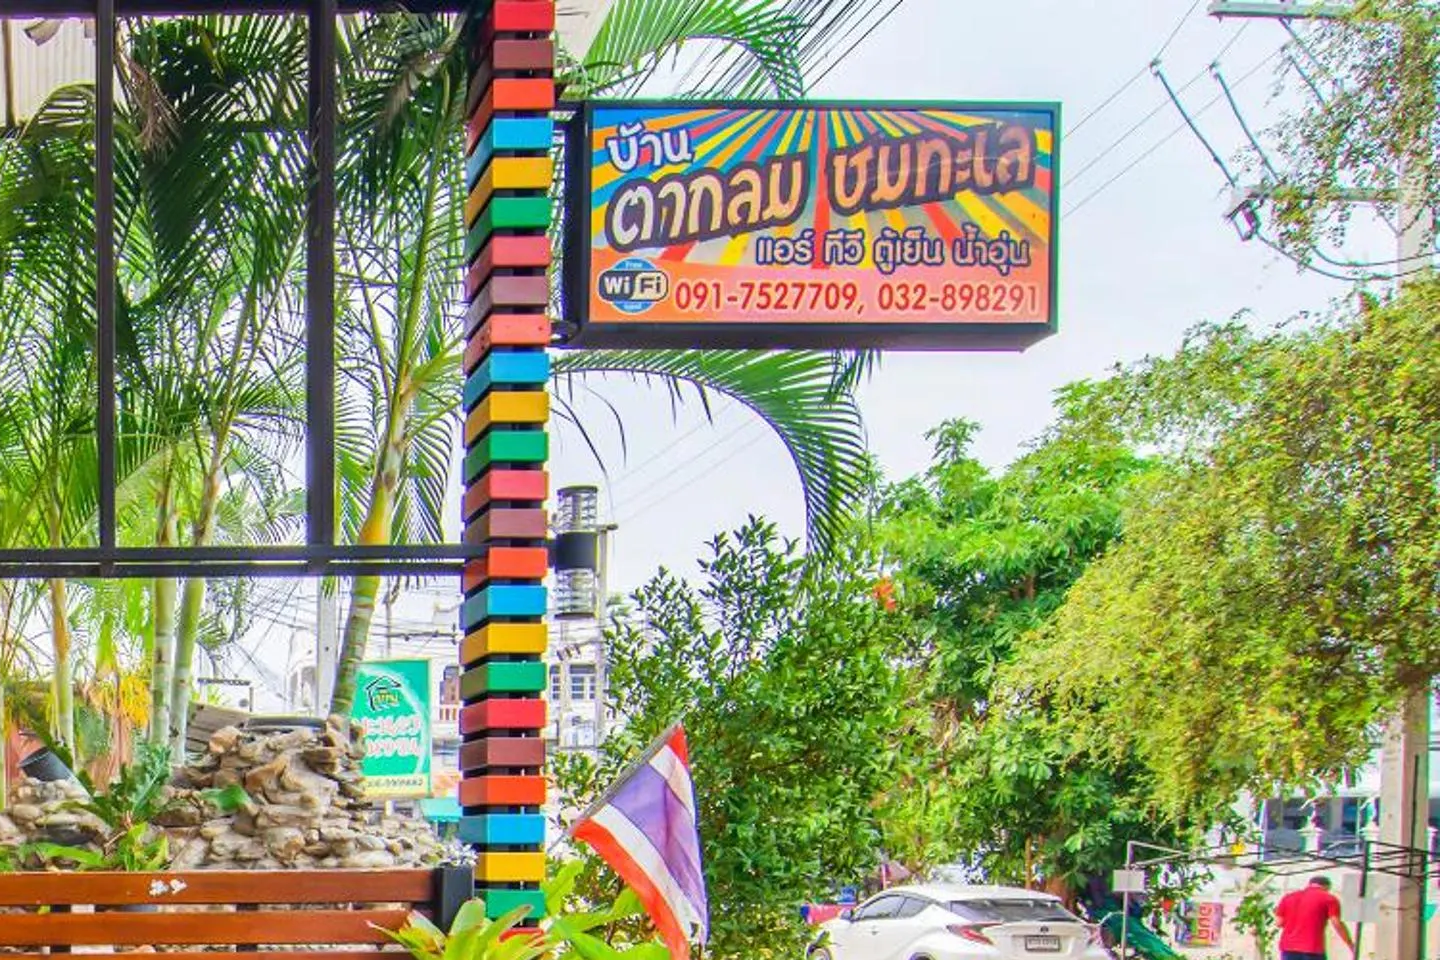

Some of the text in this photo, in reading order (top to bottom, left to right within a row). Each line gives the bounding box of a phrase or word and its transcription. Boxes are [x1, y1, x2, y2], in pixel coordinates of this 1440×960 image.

[607, 122, 693, 172] บ้าน
[611, 125, 1031, 246] ตากลม ชมทะเล
[757, 229, 813, 264] แอร์
[874, 228, 943, 273] ตู้เย็น
[954, 224, 1030, 274] น้ำอุ่น
[675, 281, 1037, 314] 091-7527709, 032-898291
